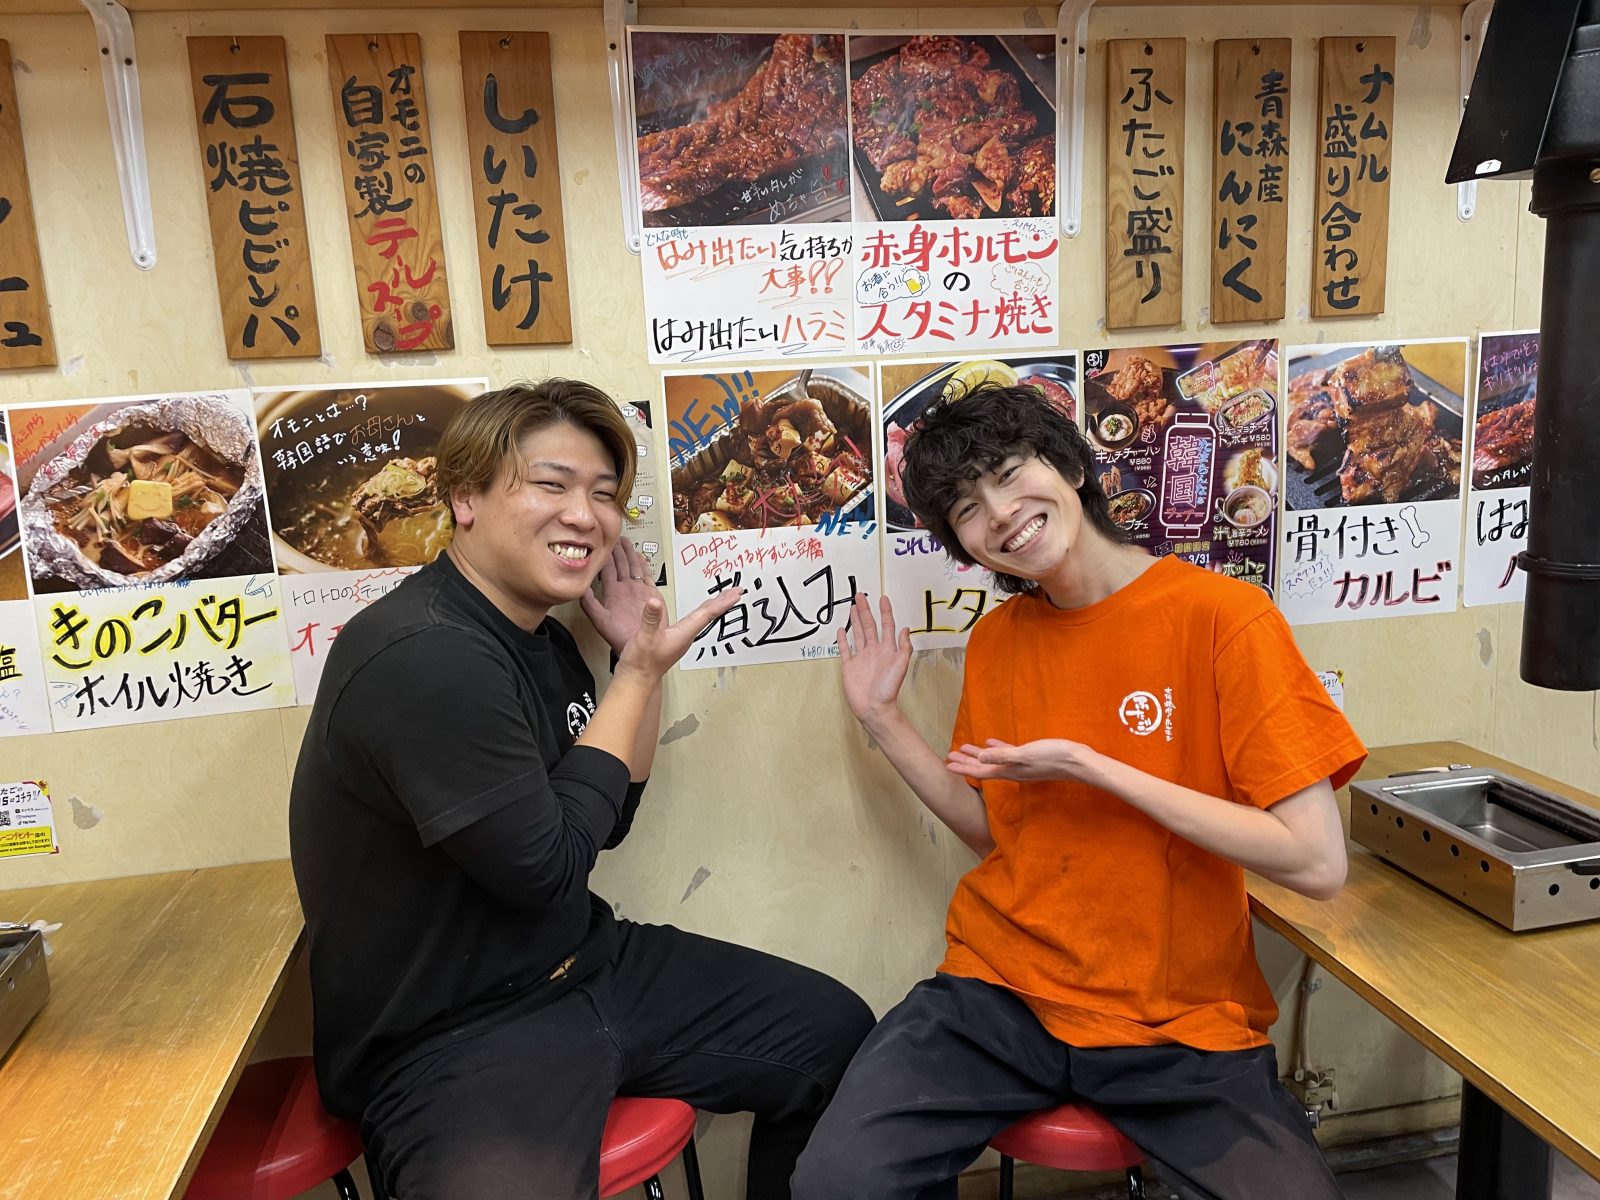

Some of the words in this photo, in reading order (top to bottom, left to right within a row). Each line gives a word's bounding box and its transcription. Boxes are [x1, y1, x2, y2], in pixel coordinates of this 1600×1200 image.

[343, 75, 414, 220] 自家製
[388, 64, 428, 184] オモニの
[1254, 69, 1290, 204] 青森産
[1356, 63, 1394, 184] ナムル
[483, 72, 553, 330] しいたけ
[1120, 67, 1174, 304] ふたご盛り
[1218, 119, 1263, 304] にんにく
[1320, 104, 1362, 310] 盛り合わせ
[861, 223, 1058, 272] 赤身ホルモン
[862, 270, 891, 292] お酒に
[943, 271, 971, 292] の
[652, 310, 846, 354] はみ出たいハラミ
[856, 290, 1054, 341] スタミナ焼き
[668, 369, 760, 468] NEW!!
[1096, 446, 1160, 463] キムチチャーハン
[1166, 435, 1200, 508] 韓国
[680, 535, 739, 566] 口の中で
[1222, 557, 1266, 576] ホットク
[1286, 513, 1399, 562] 骨付き
[1286, 558, 1324, 591] スペアリブ
[1333, 560, 1452, 610] カルビ
[52, 596, 278, 669] きのこバター
[75, 655, 273, 717] ホイル焼き
